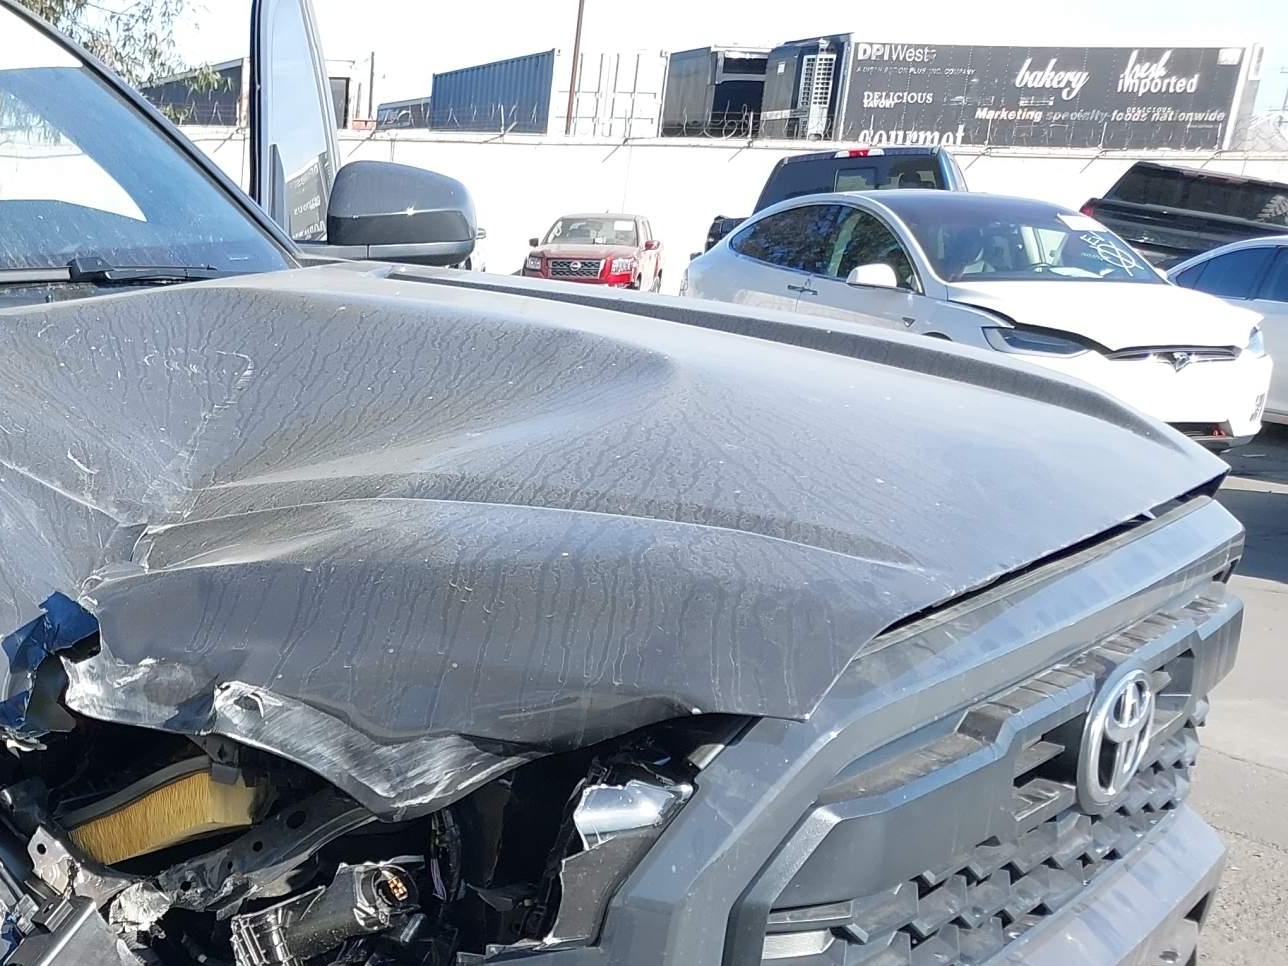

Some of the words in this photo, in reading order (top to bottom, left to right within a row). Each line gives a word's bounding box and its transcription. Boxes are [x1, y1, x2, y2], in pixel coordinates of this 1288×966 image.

[1015, 57, 1090, 101] bakery
[1116, 73, 1200, 97] imported
[863, 91, 934, 104] DELICIOUS
[974, 107, 1043, 123] Marketing
